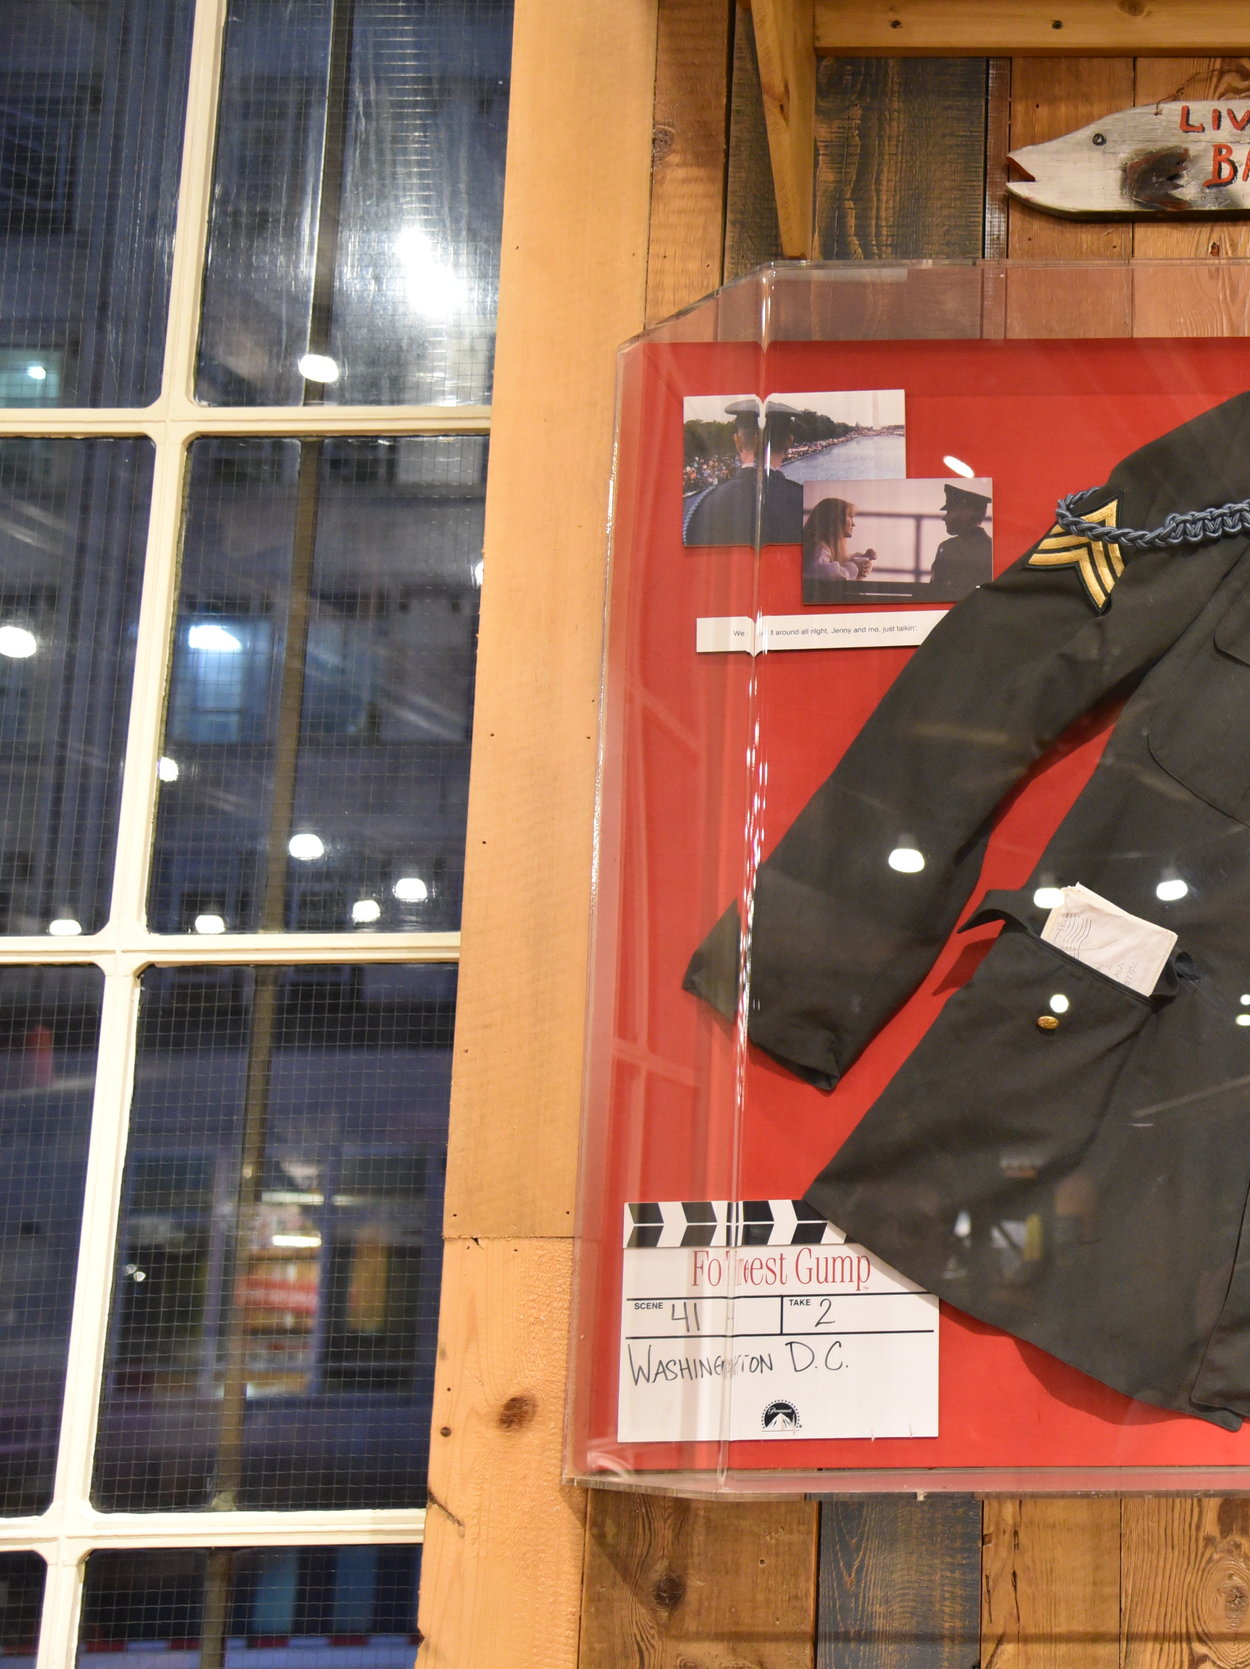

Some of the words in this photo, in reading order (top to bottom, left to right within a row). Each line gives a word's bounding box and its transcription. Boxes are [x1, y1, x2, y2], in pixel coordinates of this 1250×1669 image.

[775, 628, 799, 636] around
[831, 627, 852, 635] Jenny
[882, 626, 895, 634] just
[795, 1247, 871, 1291] Gump
[634, 1302, 664, 1310] SCENE
[671, 1302, 701, 1332] 41
[814, 1298, 836, 1328] 2
